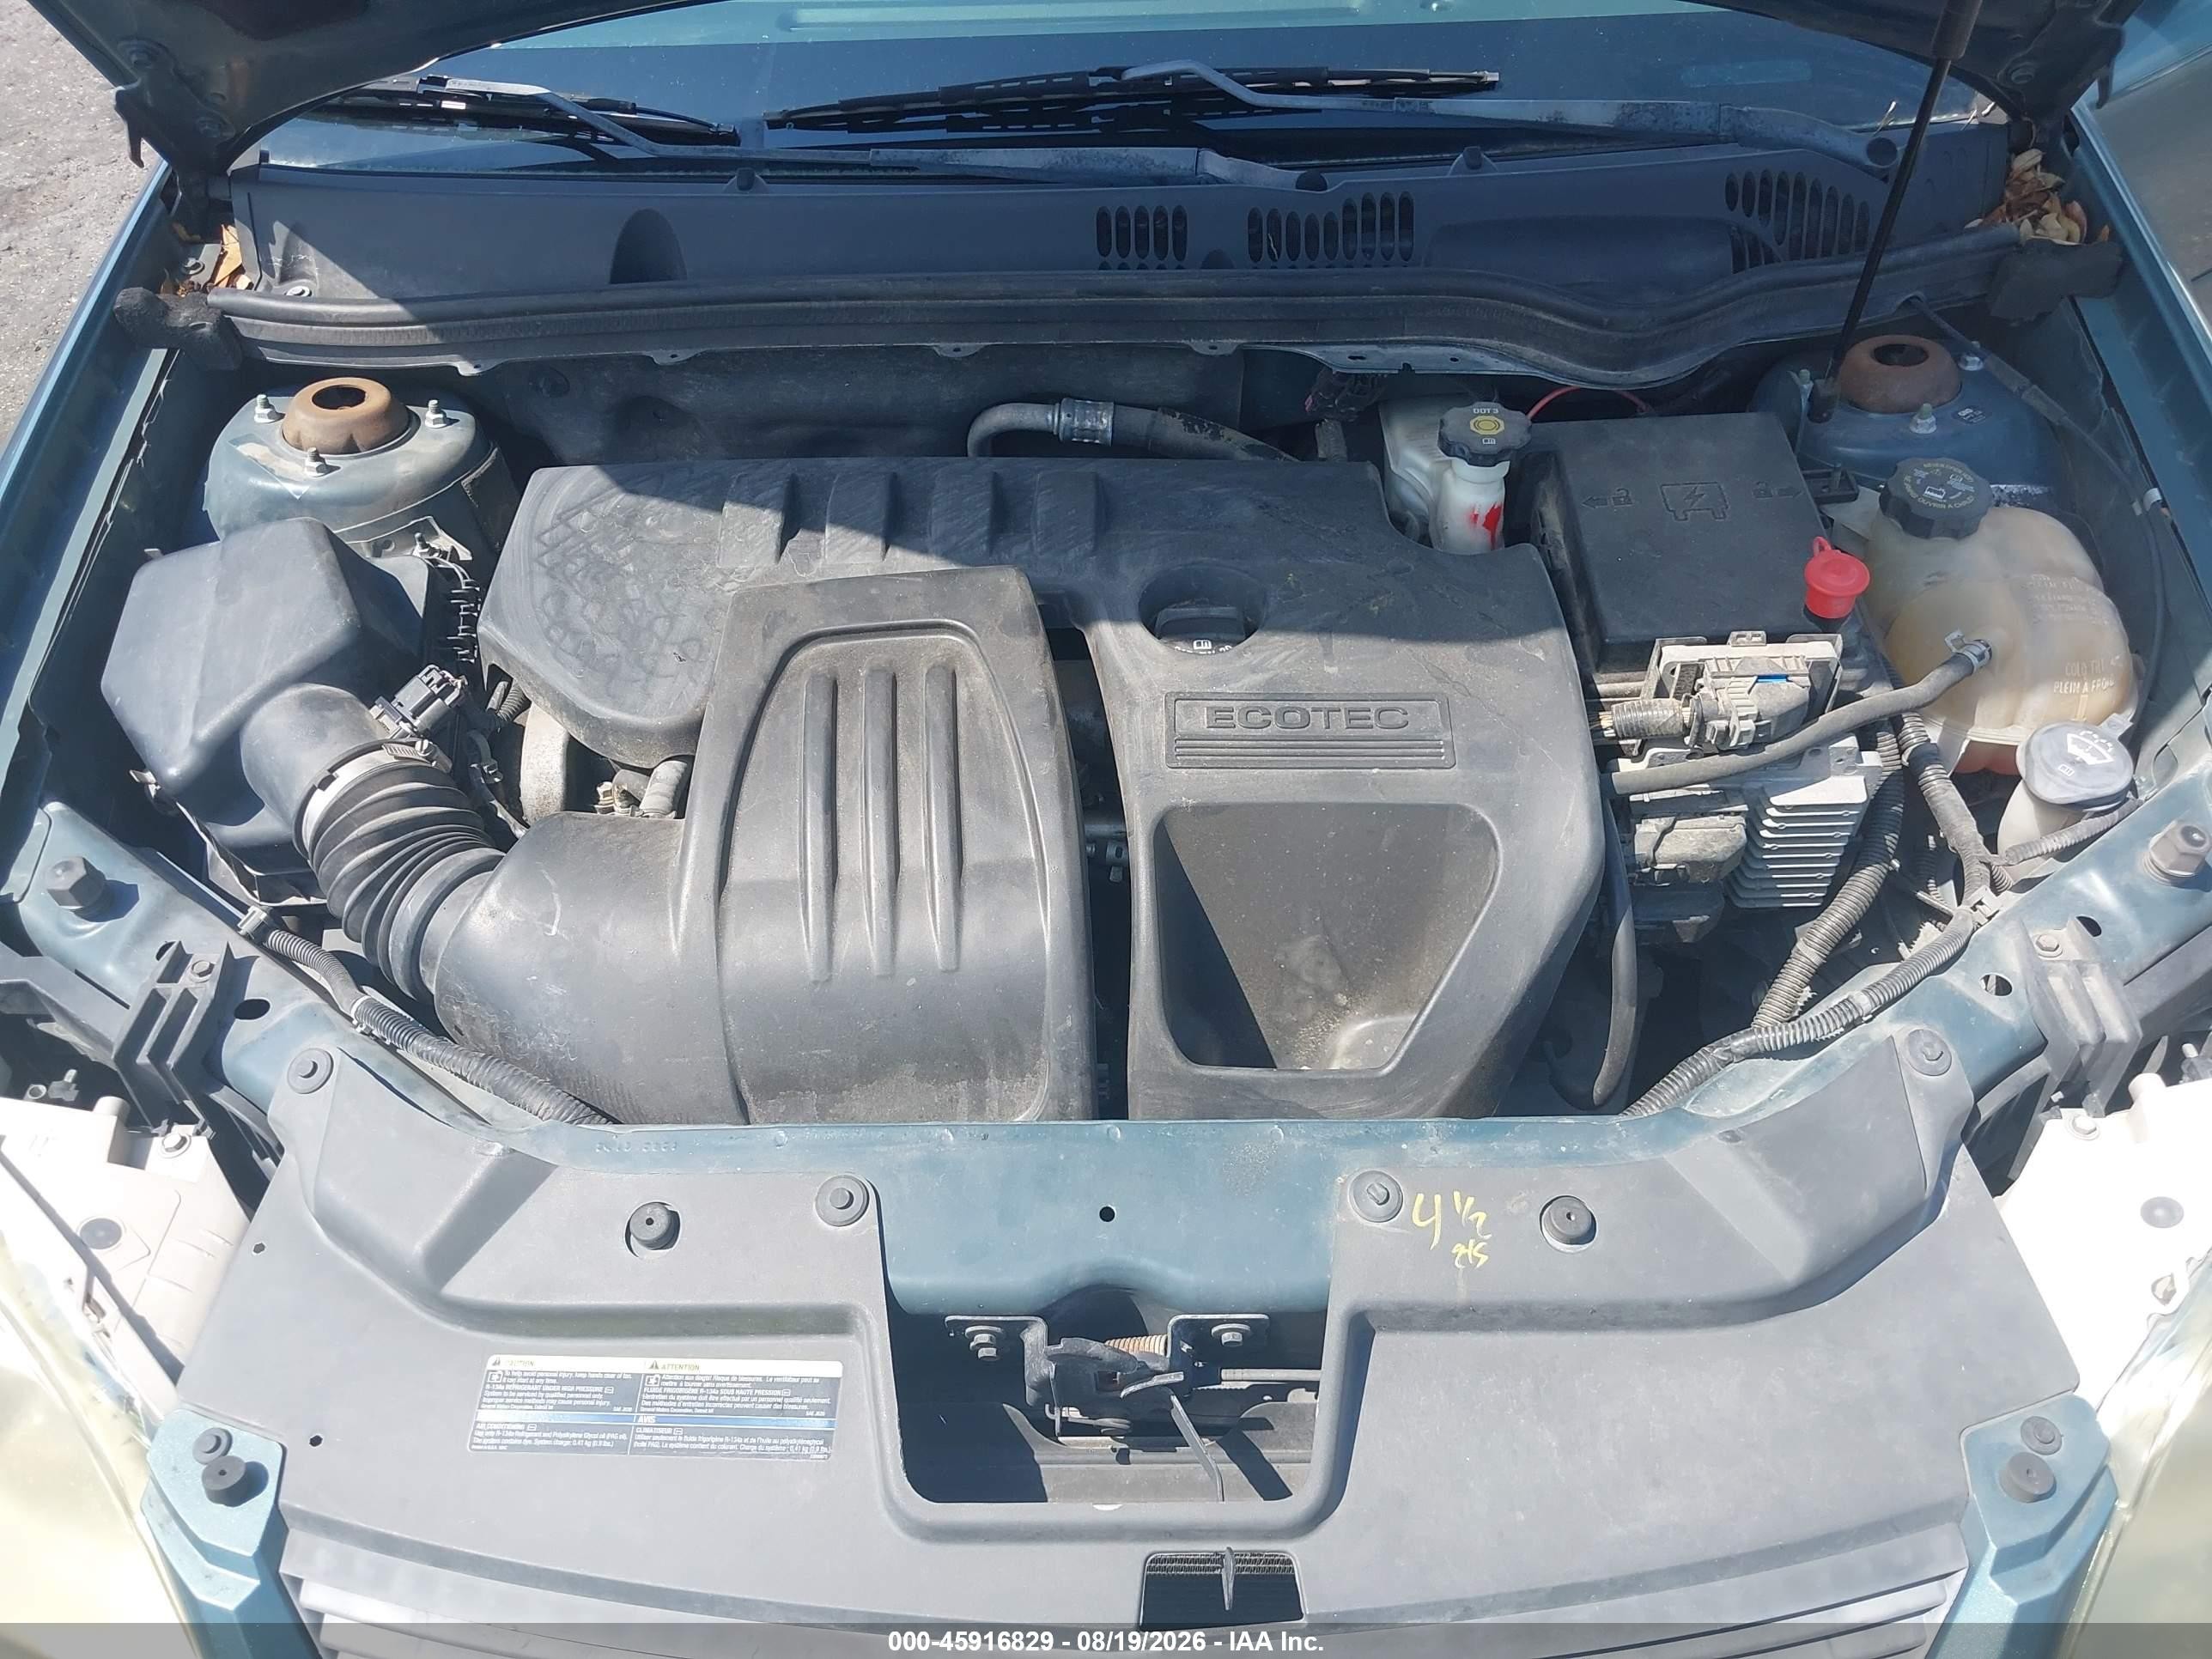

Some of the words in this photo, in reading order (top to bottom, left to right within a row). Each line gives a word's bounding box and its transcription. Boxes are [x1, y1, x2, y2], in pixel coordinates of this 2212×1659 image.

[2053, 680, 2080, 694] PLEIN
[1412, 1193, 1442, 1250] 4
[1205, 1564, 1409, 1589] ECOTEC
